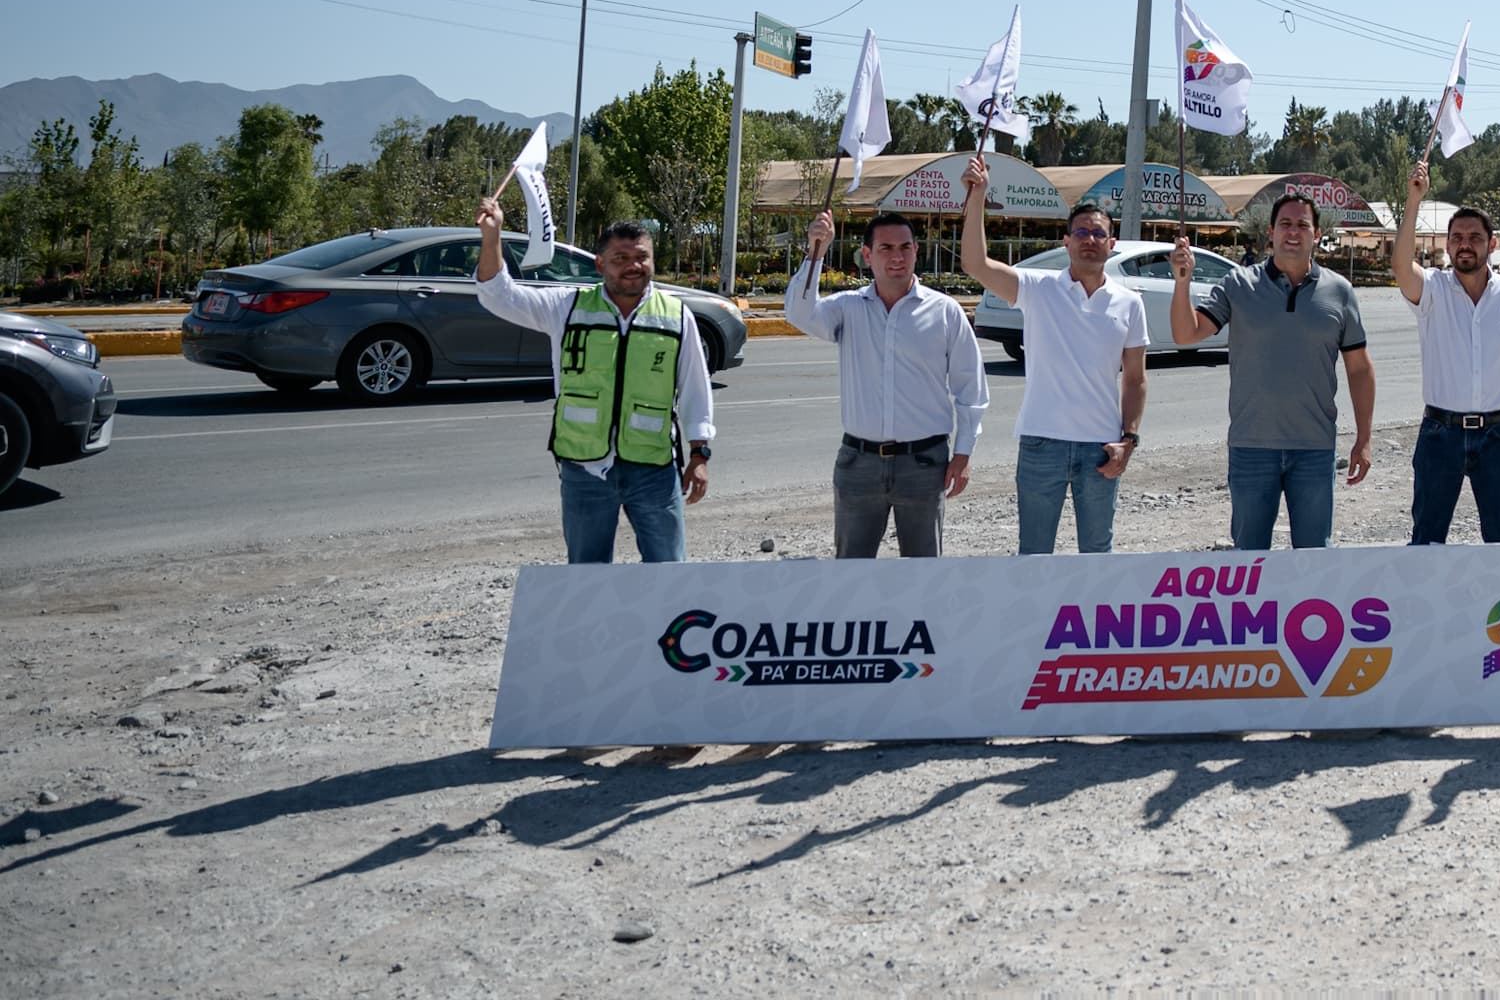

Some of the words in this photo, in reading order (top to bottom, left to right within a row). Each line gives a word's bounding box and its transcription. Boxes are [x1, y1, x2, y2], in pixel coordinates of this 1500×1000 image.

[915, 170, 944, 179] VENTA
[906, 179, 918, 188] DE
[920, 180, 950, 189] PASTO
[1007, 184, 1046, 195] PLANTAS
[1049, 188, 1059, 196] DE
[905, 189, 917, 198] EN
[920, 190, 950, 199] ROLLO
[895, 199, 926, 208] TIERRA
[929, 200, 960, 209] NEGRA
[1006, 197, 1059, 208] TEMPORADA
[1151, 557, 1266, 599] AQUÍ
[657, 609, 936, 673] COAHUILA
[1044, 597, 1392, 686] ANDAMOS
[795, 663, 885, 680] DELANTE
[1055, 663, 1281, 692] TRABAJANDO
